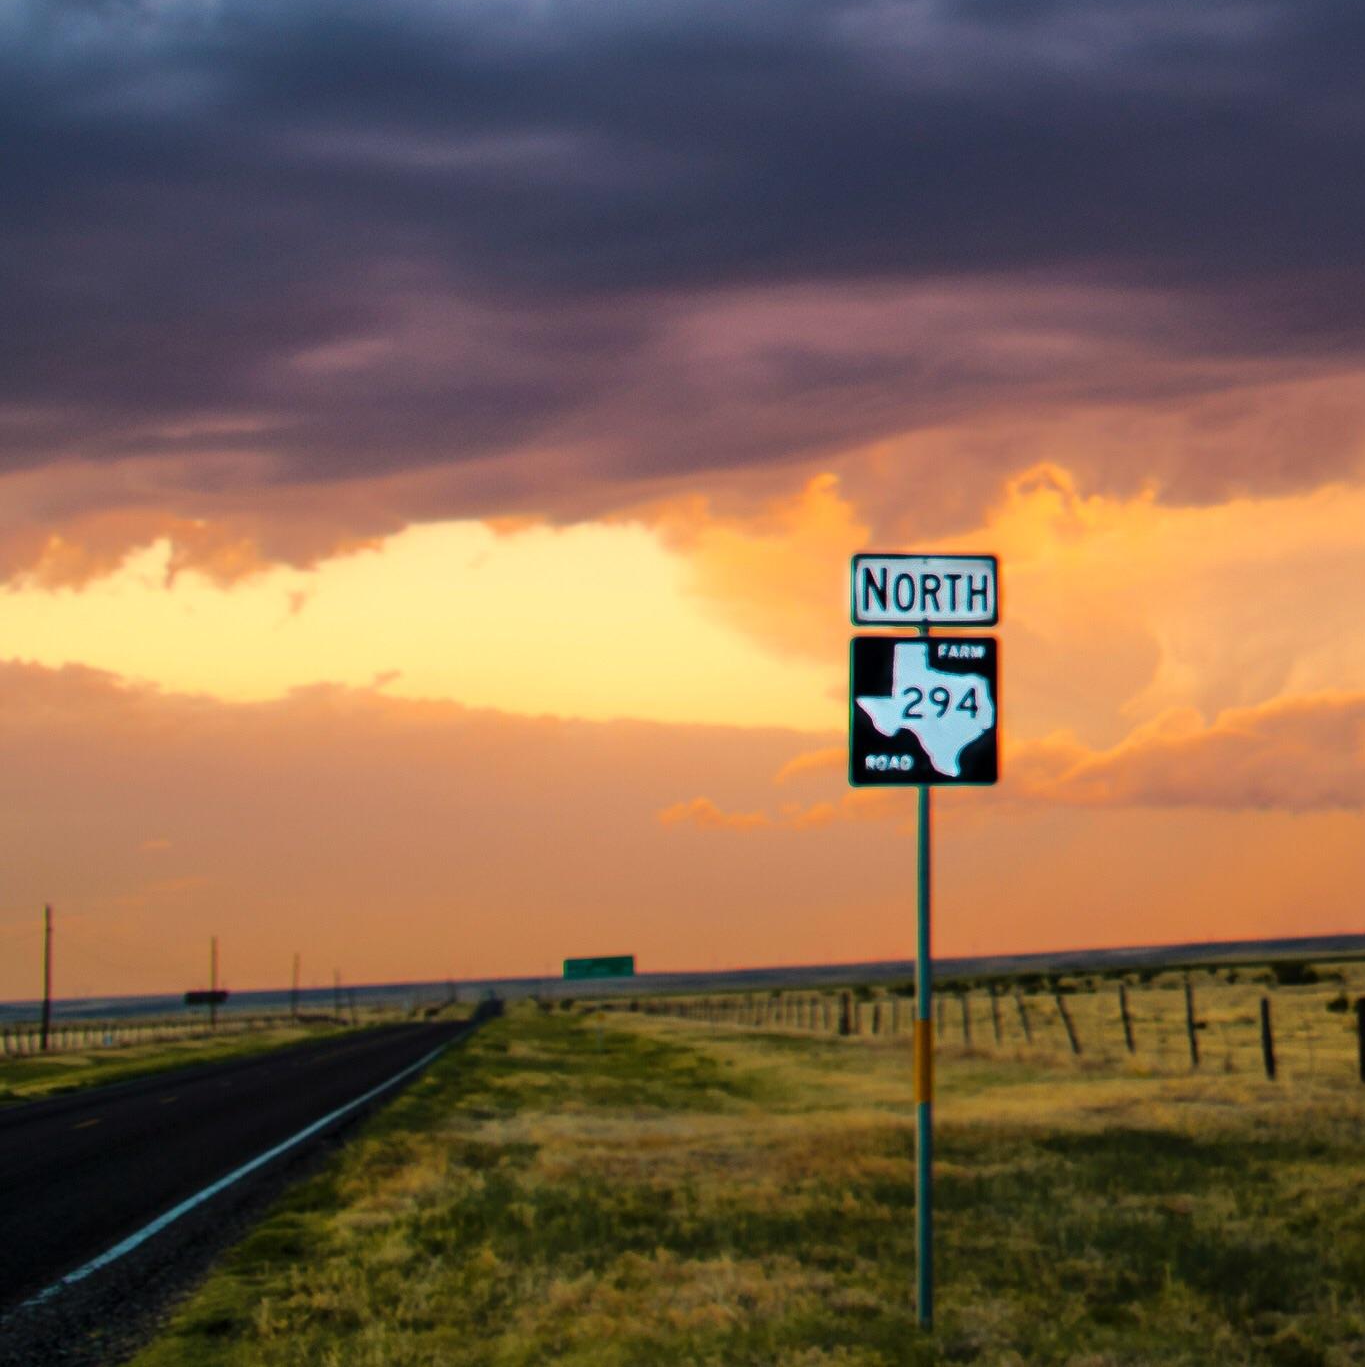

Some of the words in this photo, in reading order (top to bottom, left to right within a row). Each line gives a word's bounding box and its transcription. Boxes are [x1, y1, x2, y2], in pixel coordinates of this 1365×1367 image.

[862, 566, 988, 613] NORTH
[937, 643, 986, 660] FARM
[902, 686, 979, 720] 294
[864, 753, 915, 771] ROAD
